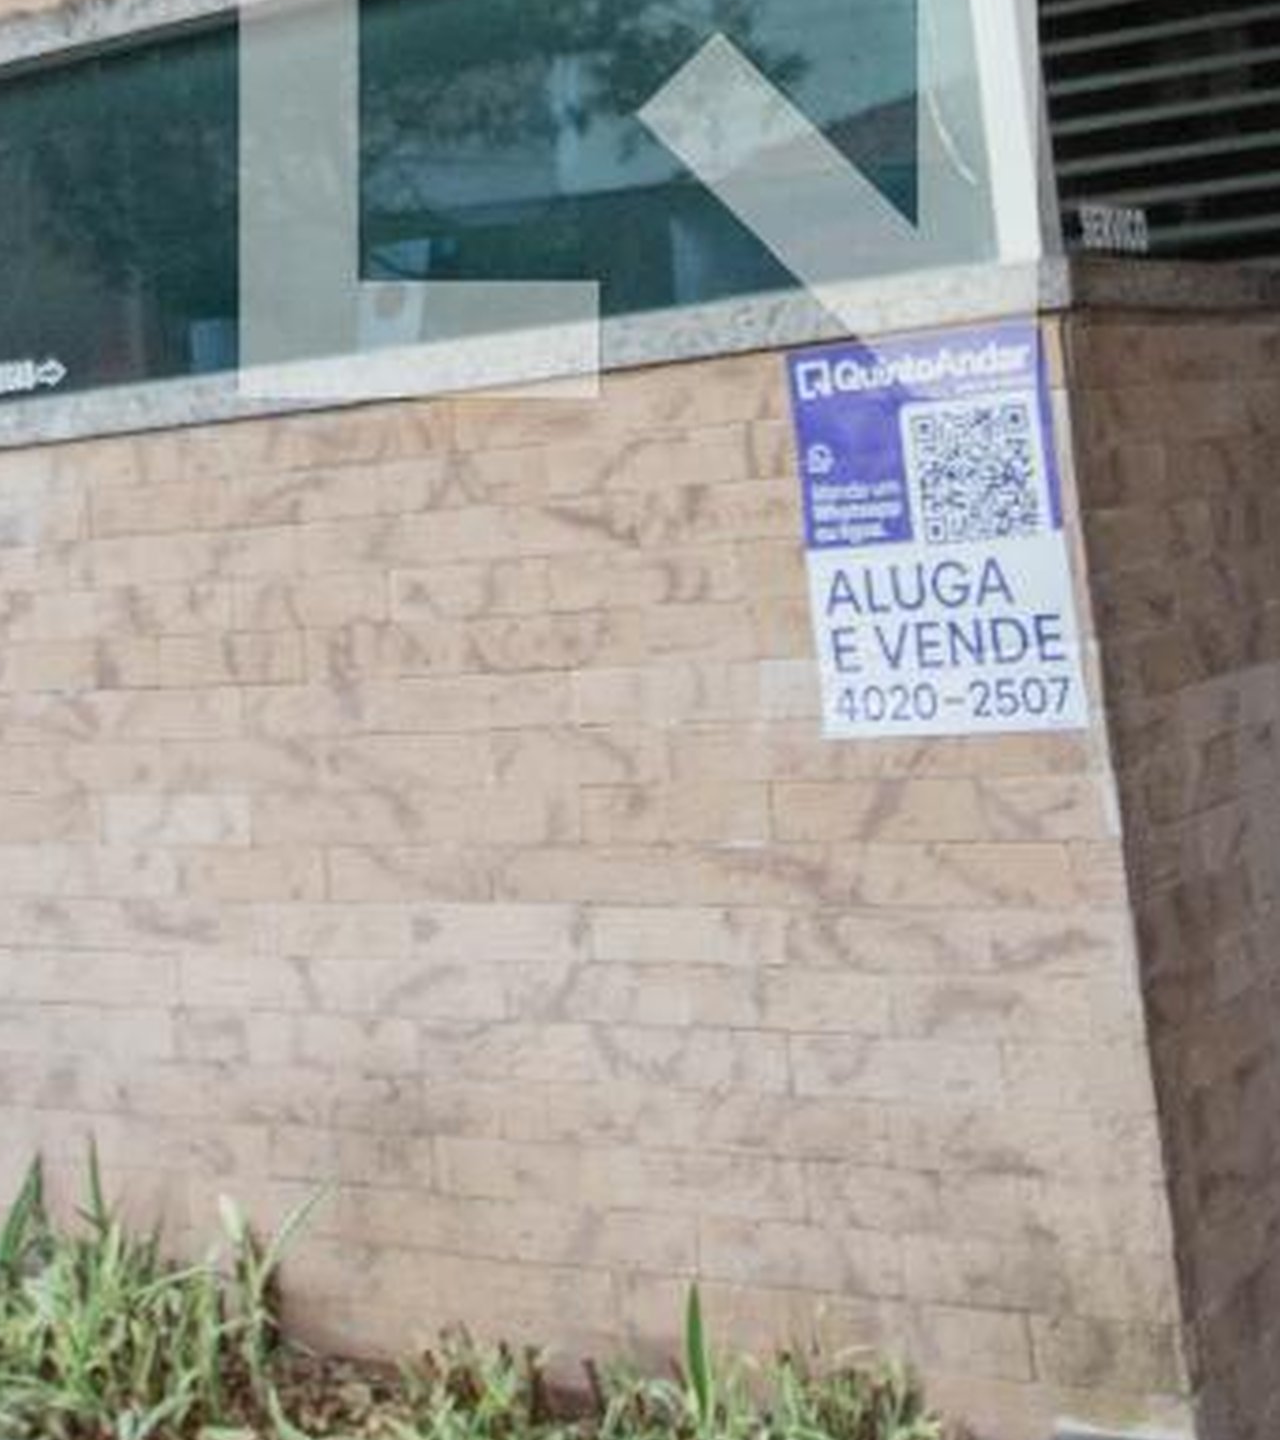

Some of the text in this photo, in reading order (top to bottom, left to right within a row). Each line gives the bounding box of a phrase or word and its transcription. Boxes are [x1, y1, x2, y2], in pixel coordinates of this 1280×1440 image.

[834, 343, 1031, 392] QuintoAndar
[827, 557, 1014, 616] ALUGA
[831, 614, 1067, 673] E VENDE
[838, 677, 1071, 722] 4020-2507
